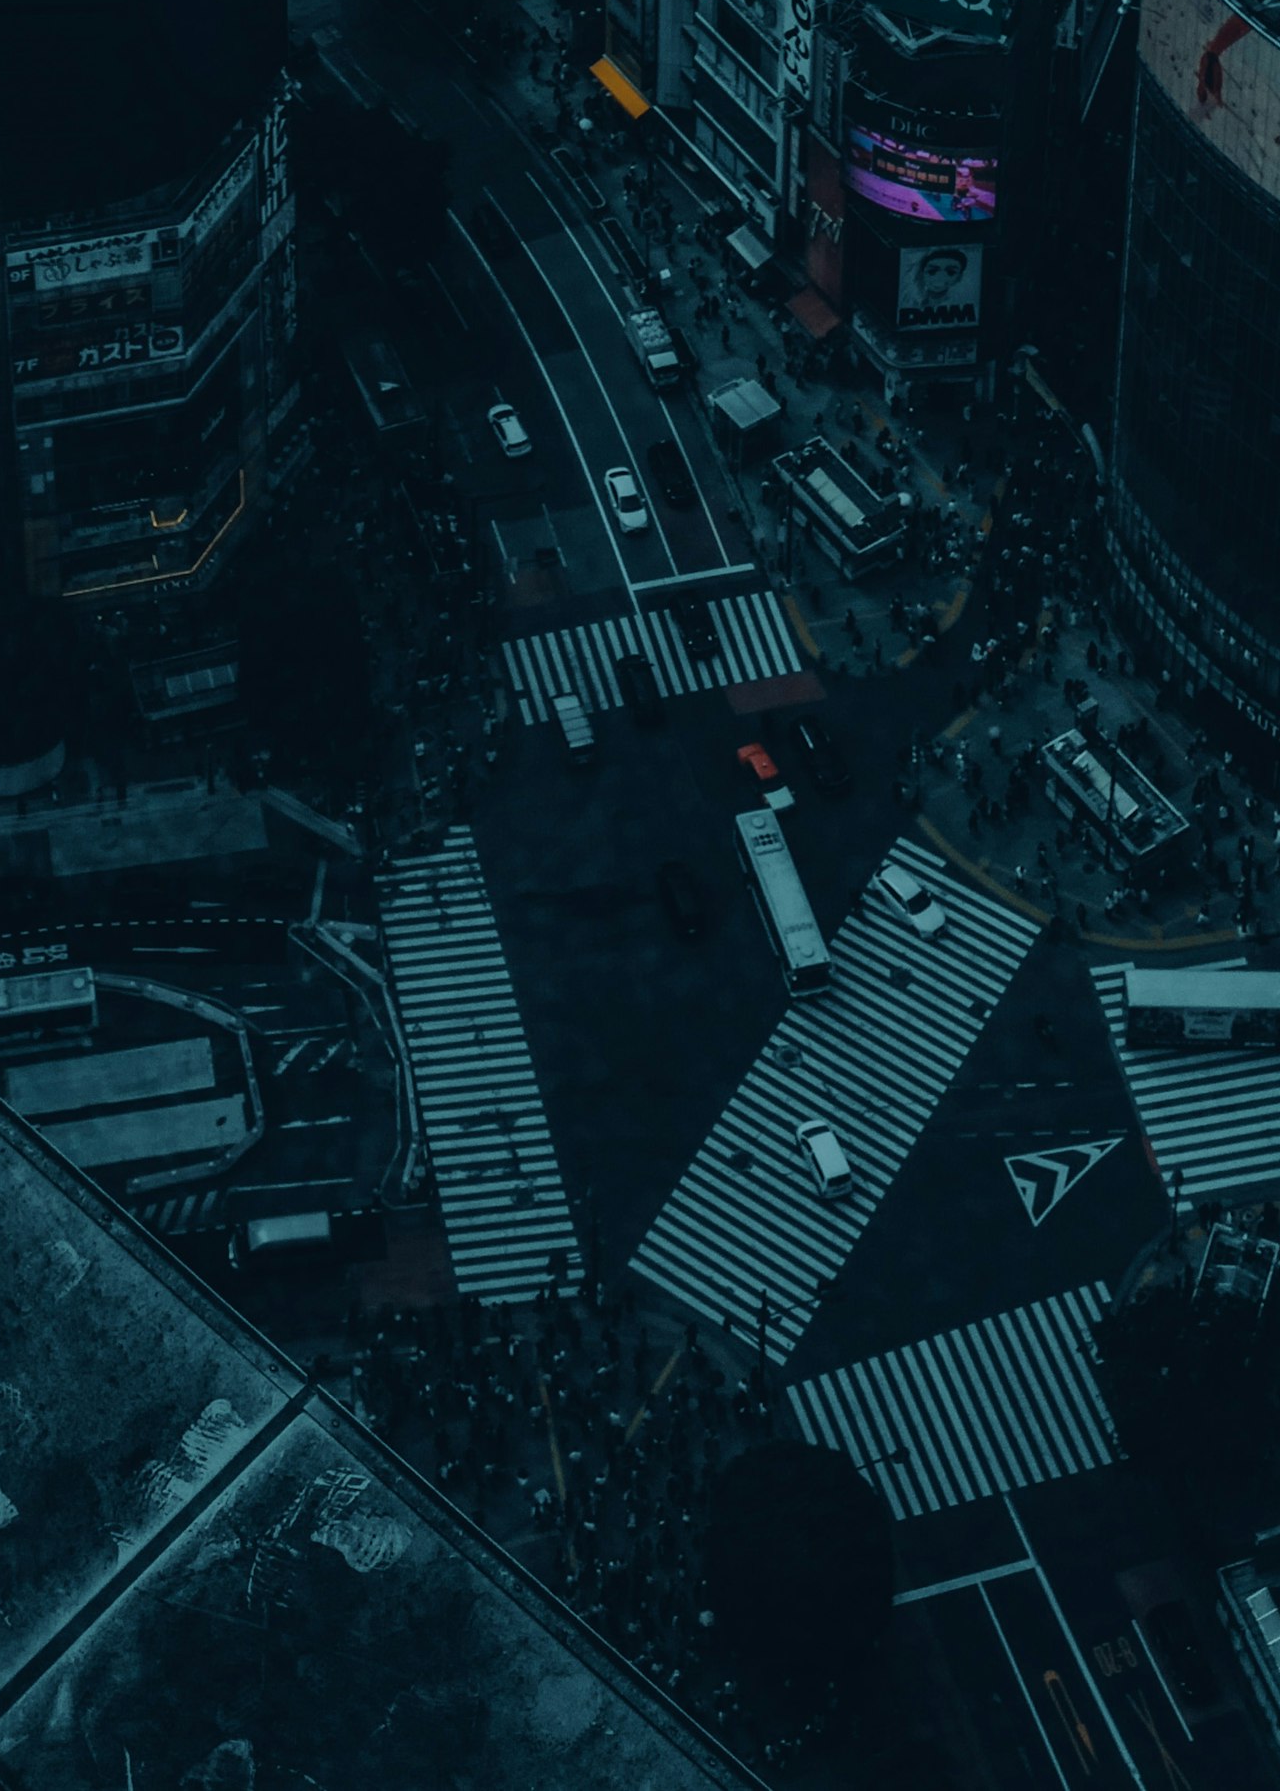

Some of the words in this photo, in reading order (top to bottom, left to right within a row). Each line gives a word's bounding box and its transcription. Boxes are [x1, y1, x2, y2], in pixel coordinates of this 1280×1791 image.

[891, 116, 938, 140] DHC
[10, 269, 32, 283] 9F
[898, 302, 977, 327] DMM
[13, 358, 40, 374] 7F
[78, 341, 144, 368] ガスト
